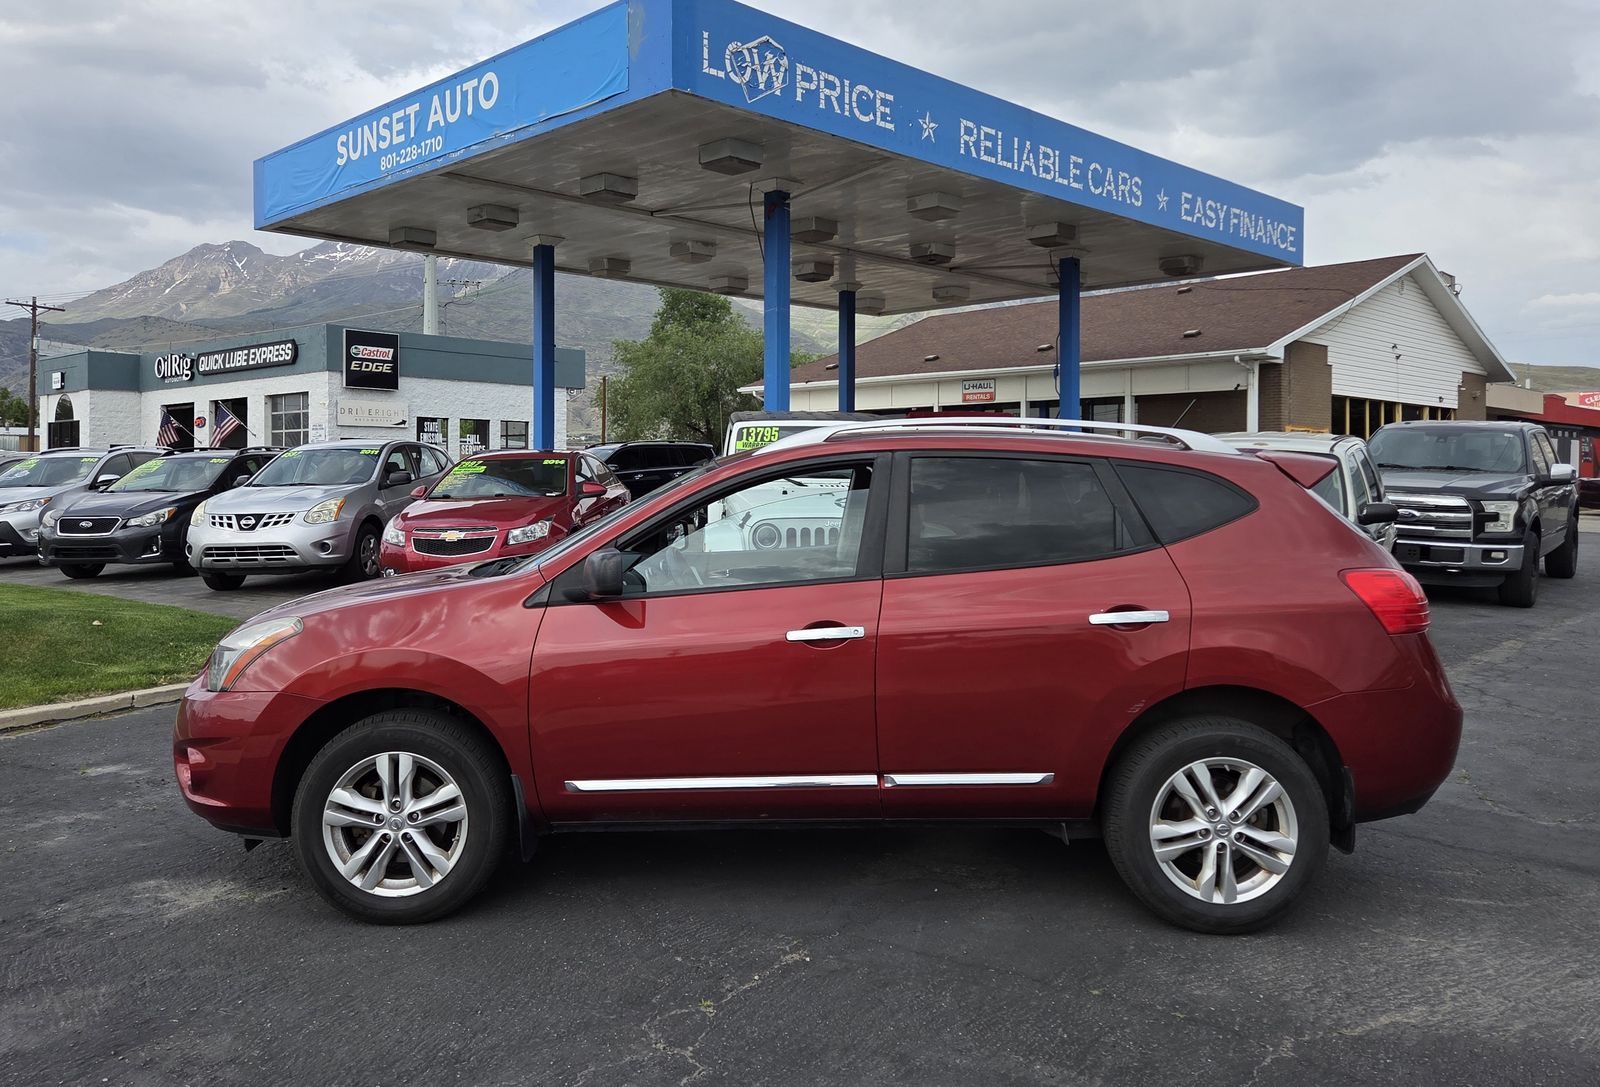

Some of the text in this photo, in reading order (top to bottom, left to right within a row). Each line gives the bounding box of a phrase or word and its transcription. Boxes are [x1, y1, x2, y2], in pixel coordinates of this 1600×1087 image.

[702, 30, 895, 132] LOW PRICE
[336, 71, 499, 166] SUNSET AUTO
[380, 135, 443, 171] 801-228-1710
[959, 118, 1143, 208] RELIABLE CARS
[1181, 191, 1297, 253] EASY FINANCE
[154, 353, 191, 381] OilRig
[199, 343, 293, 372] QUICK LUBE EXPRESS
[350, 360, 394, 373] EDGE
[361, 347, 391, 359] Castrol
[340, 407, 406, 417] DRIVERIGHT
[1585, 393, 1600, 404] CLE
[424, 421, 438, 433] STATE
[742, 427, 780, 442] 13795
